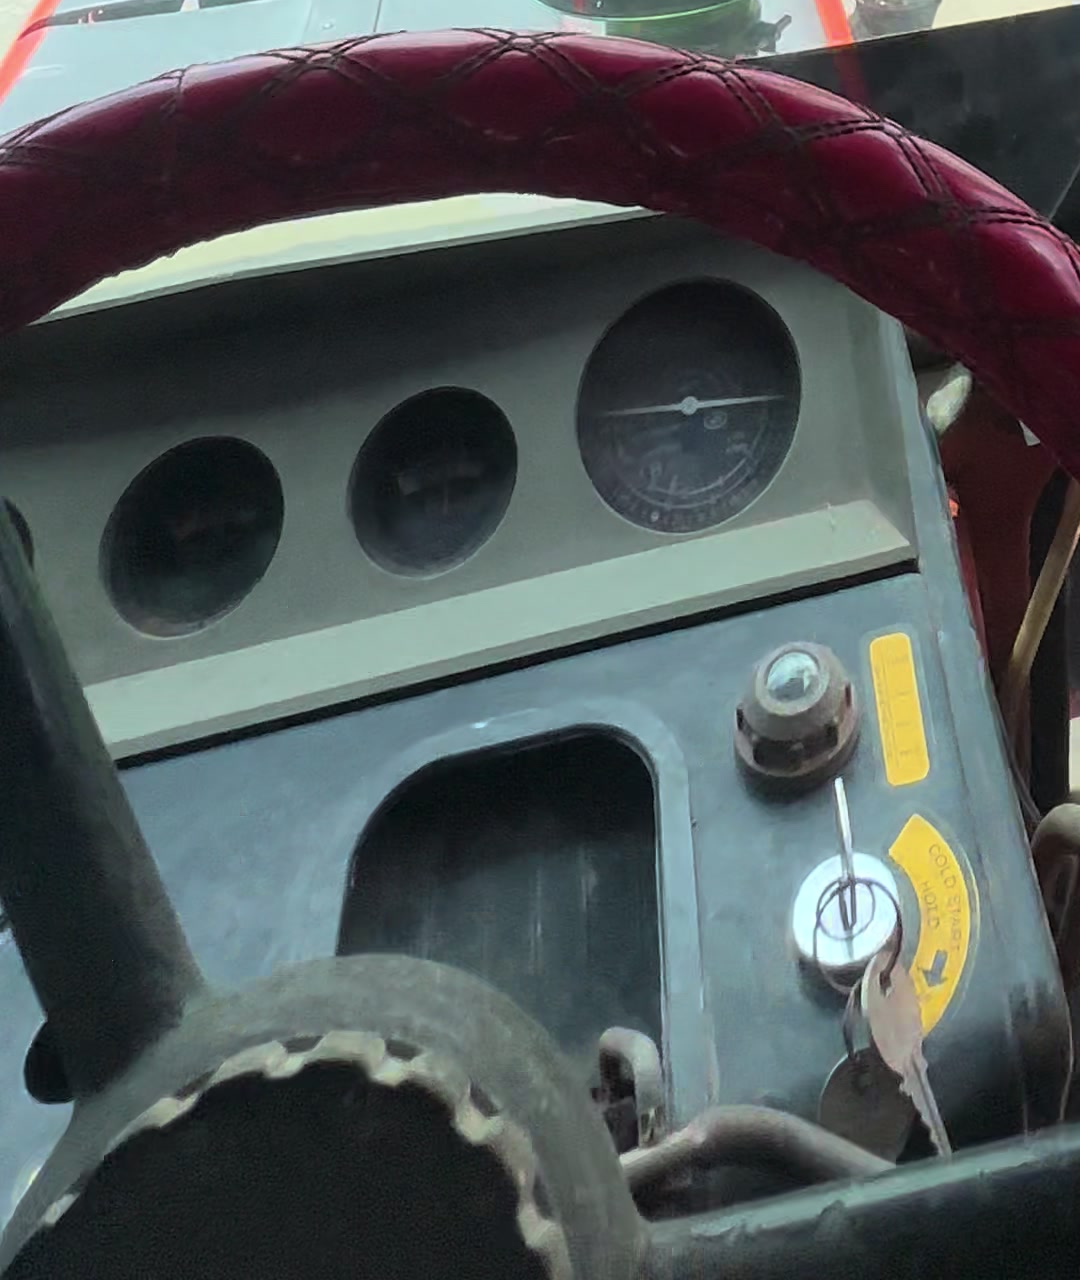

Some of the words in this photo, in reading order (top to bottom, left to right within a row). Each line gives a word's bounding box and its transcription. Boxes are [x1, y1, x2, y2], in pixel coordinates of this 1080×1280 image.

[919, 880, 940, 931] HOLD
[928, 842, 957, 890] COLD
[947, 896, 962, 952] START
